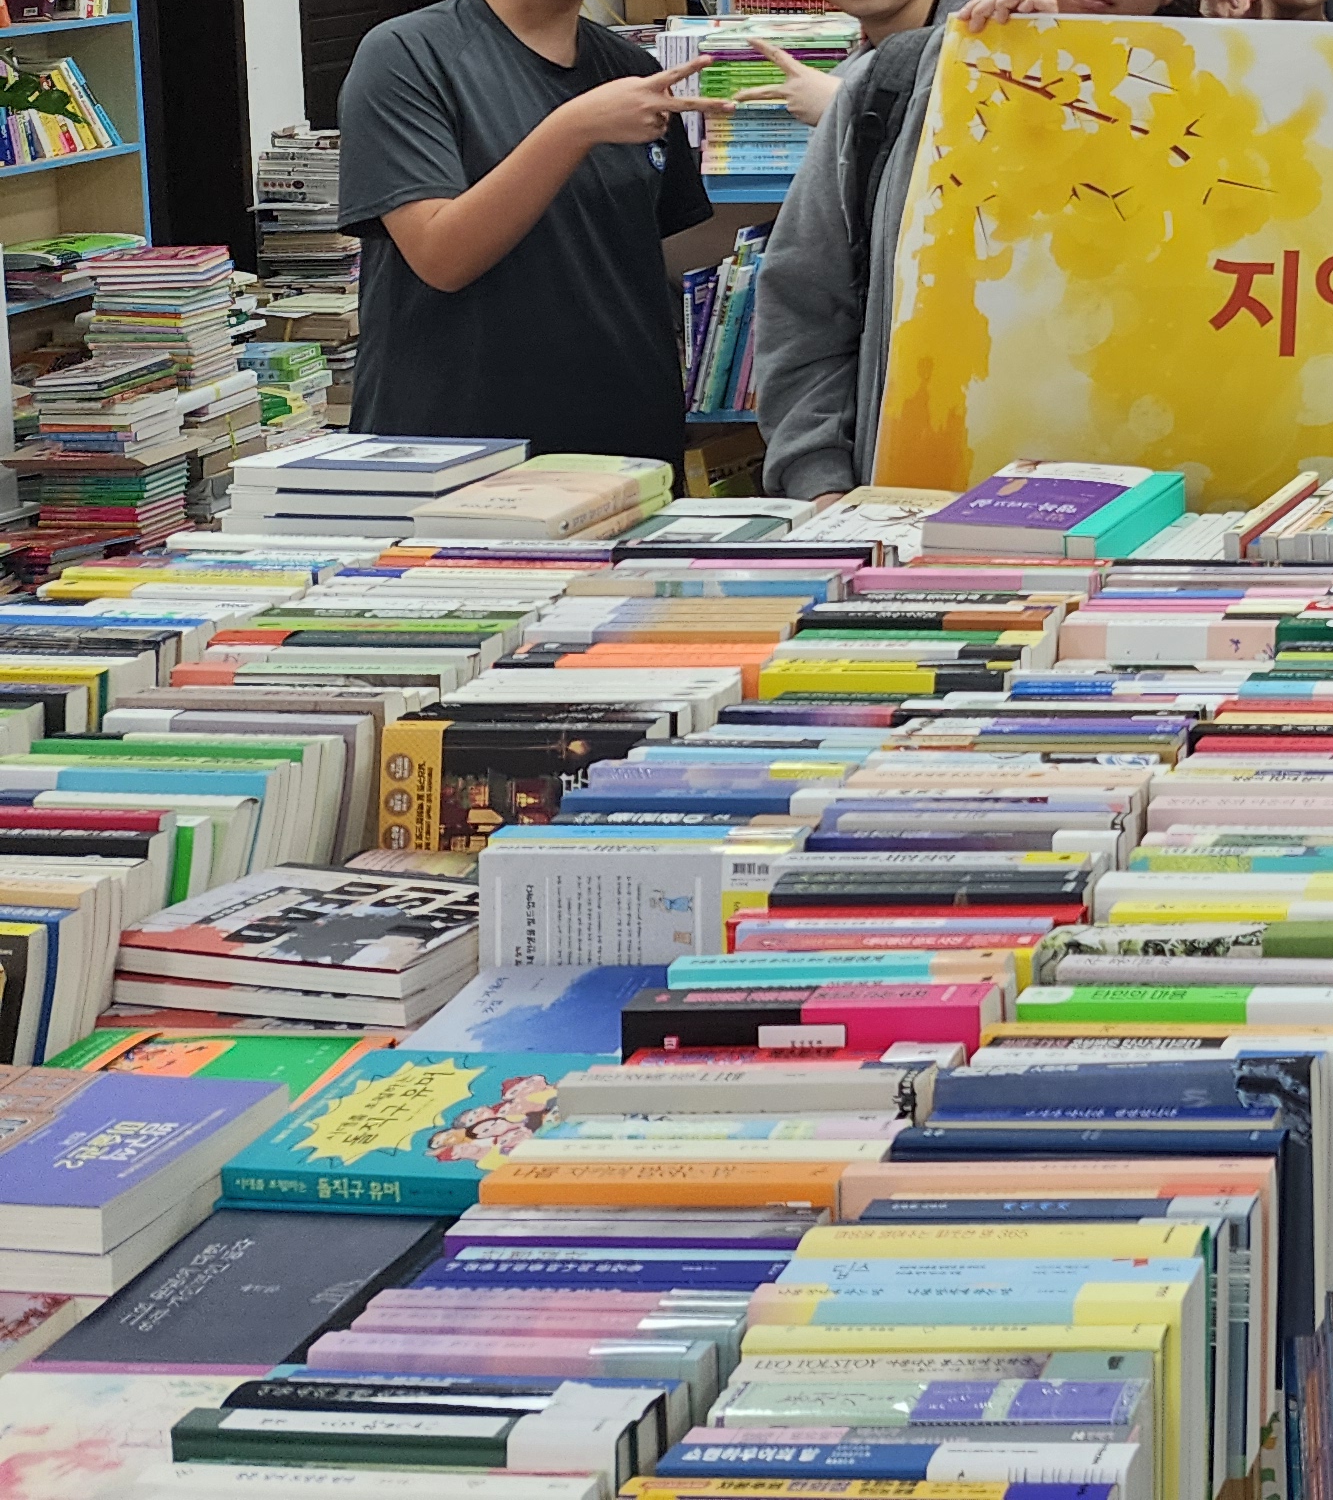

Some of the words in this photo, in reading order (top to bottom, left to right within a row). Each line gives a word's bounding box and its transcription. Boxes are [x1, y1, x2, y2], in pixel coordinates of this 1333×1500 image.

[342, 1104, 410, 1145] 돌직구
[400, 1071, 456, 1099] 유머
[317, 1178, 365, 1199] 돌직구
[370, 1181, 400, 1202] 유머
